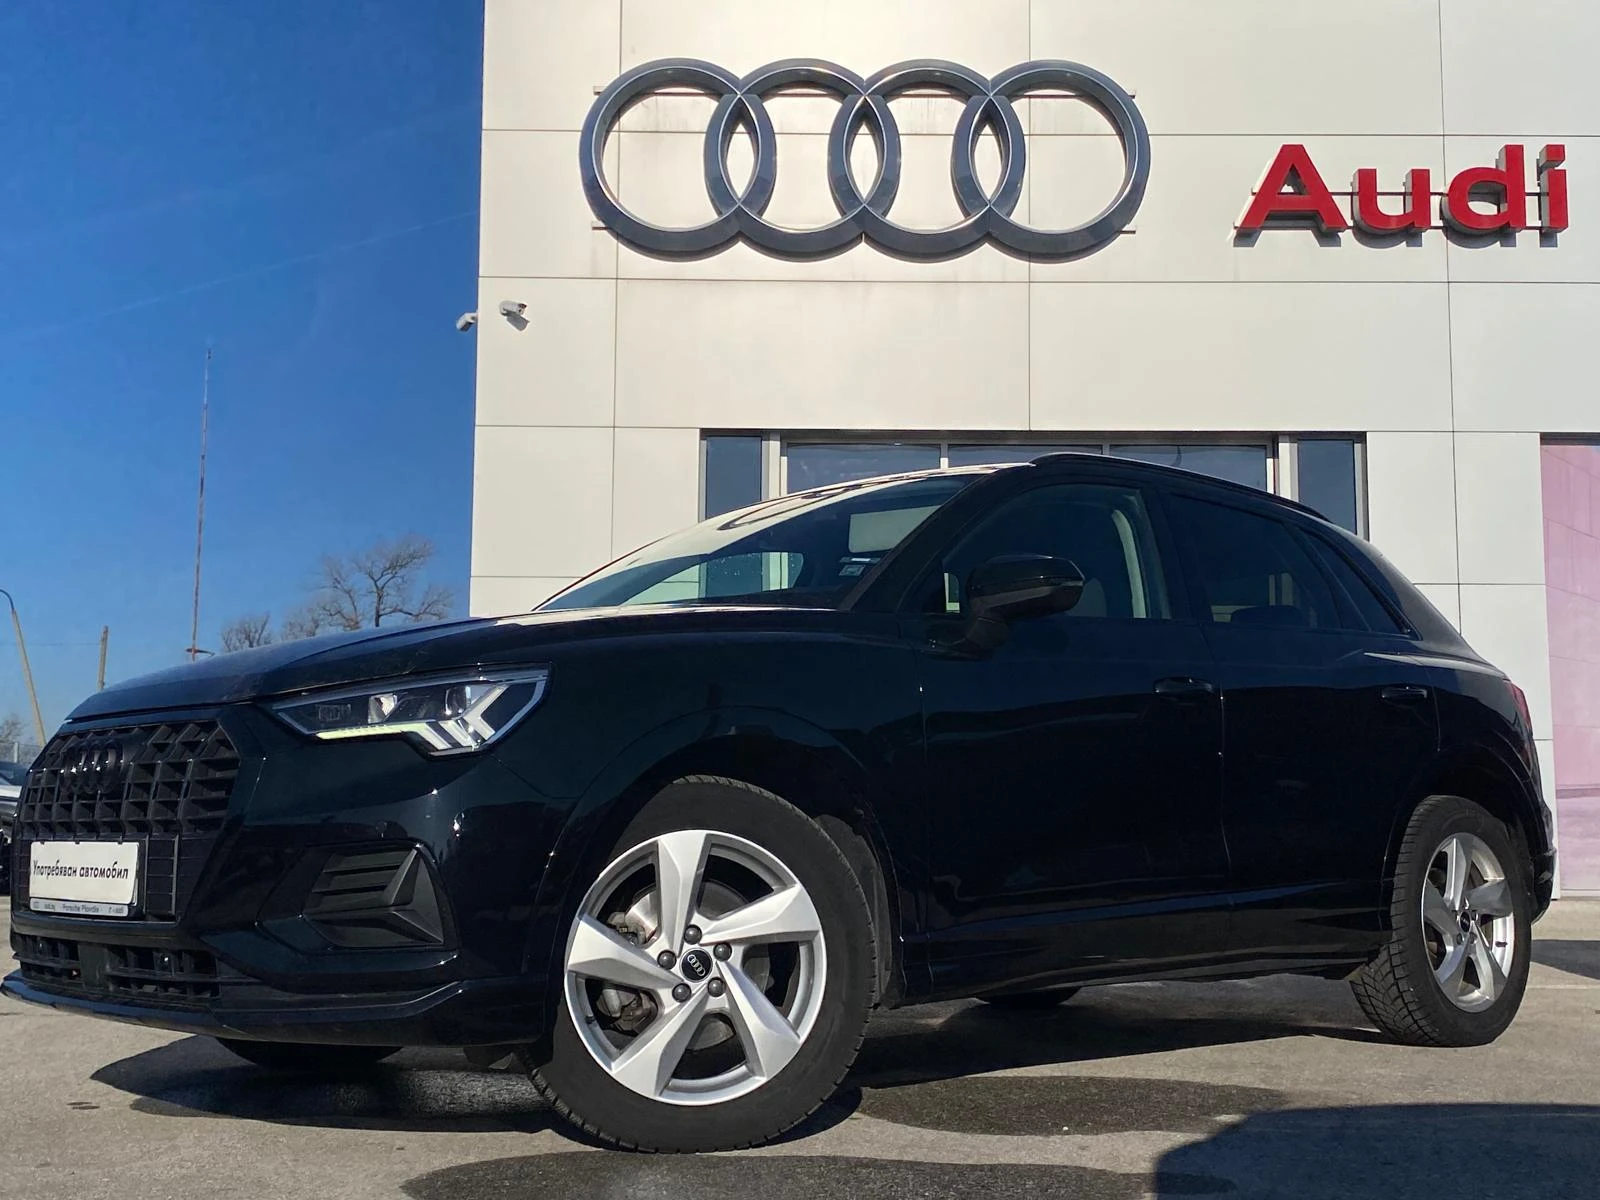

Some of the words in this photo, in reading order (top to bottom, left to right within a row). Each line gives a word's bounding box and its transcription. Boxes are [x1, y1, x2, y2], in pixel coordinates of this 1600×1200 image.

[1234, 143, 1568, 235] Audi
[33, 859, 77, 880] Употребяван
[79, 861, 129, 880] автомобил
